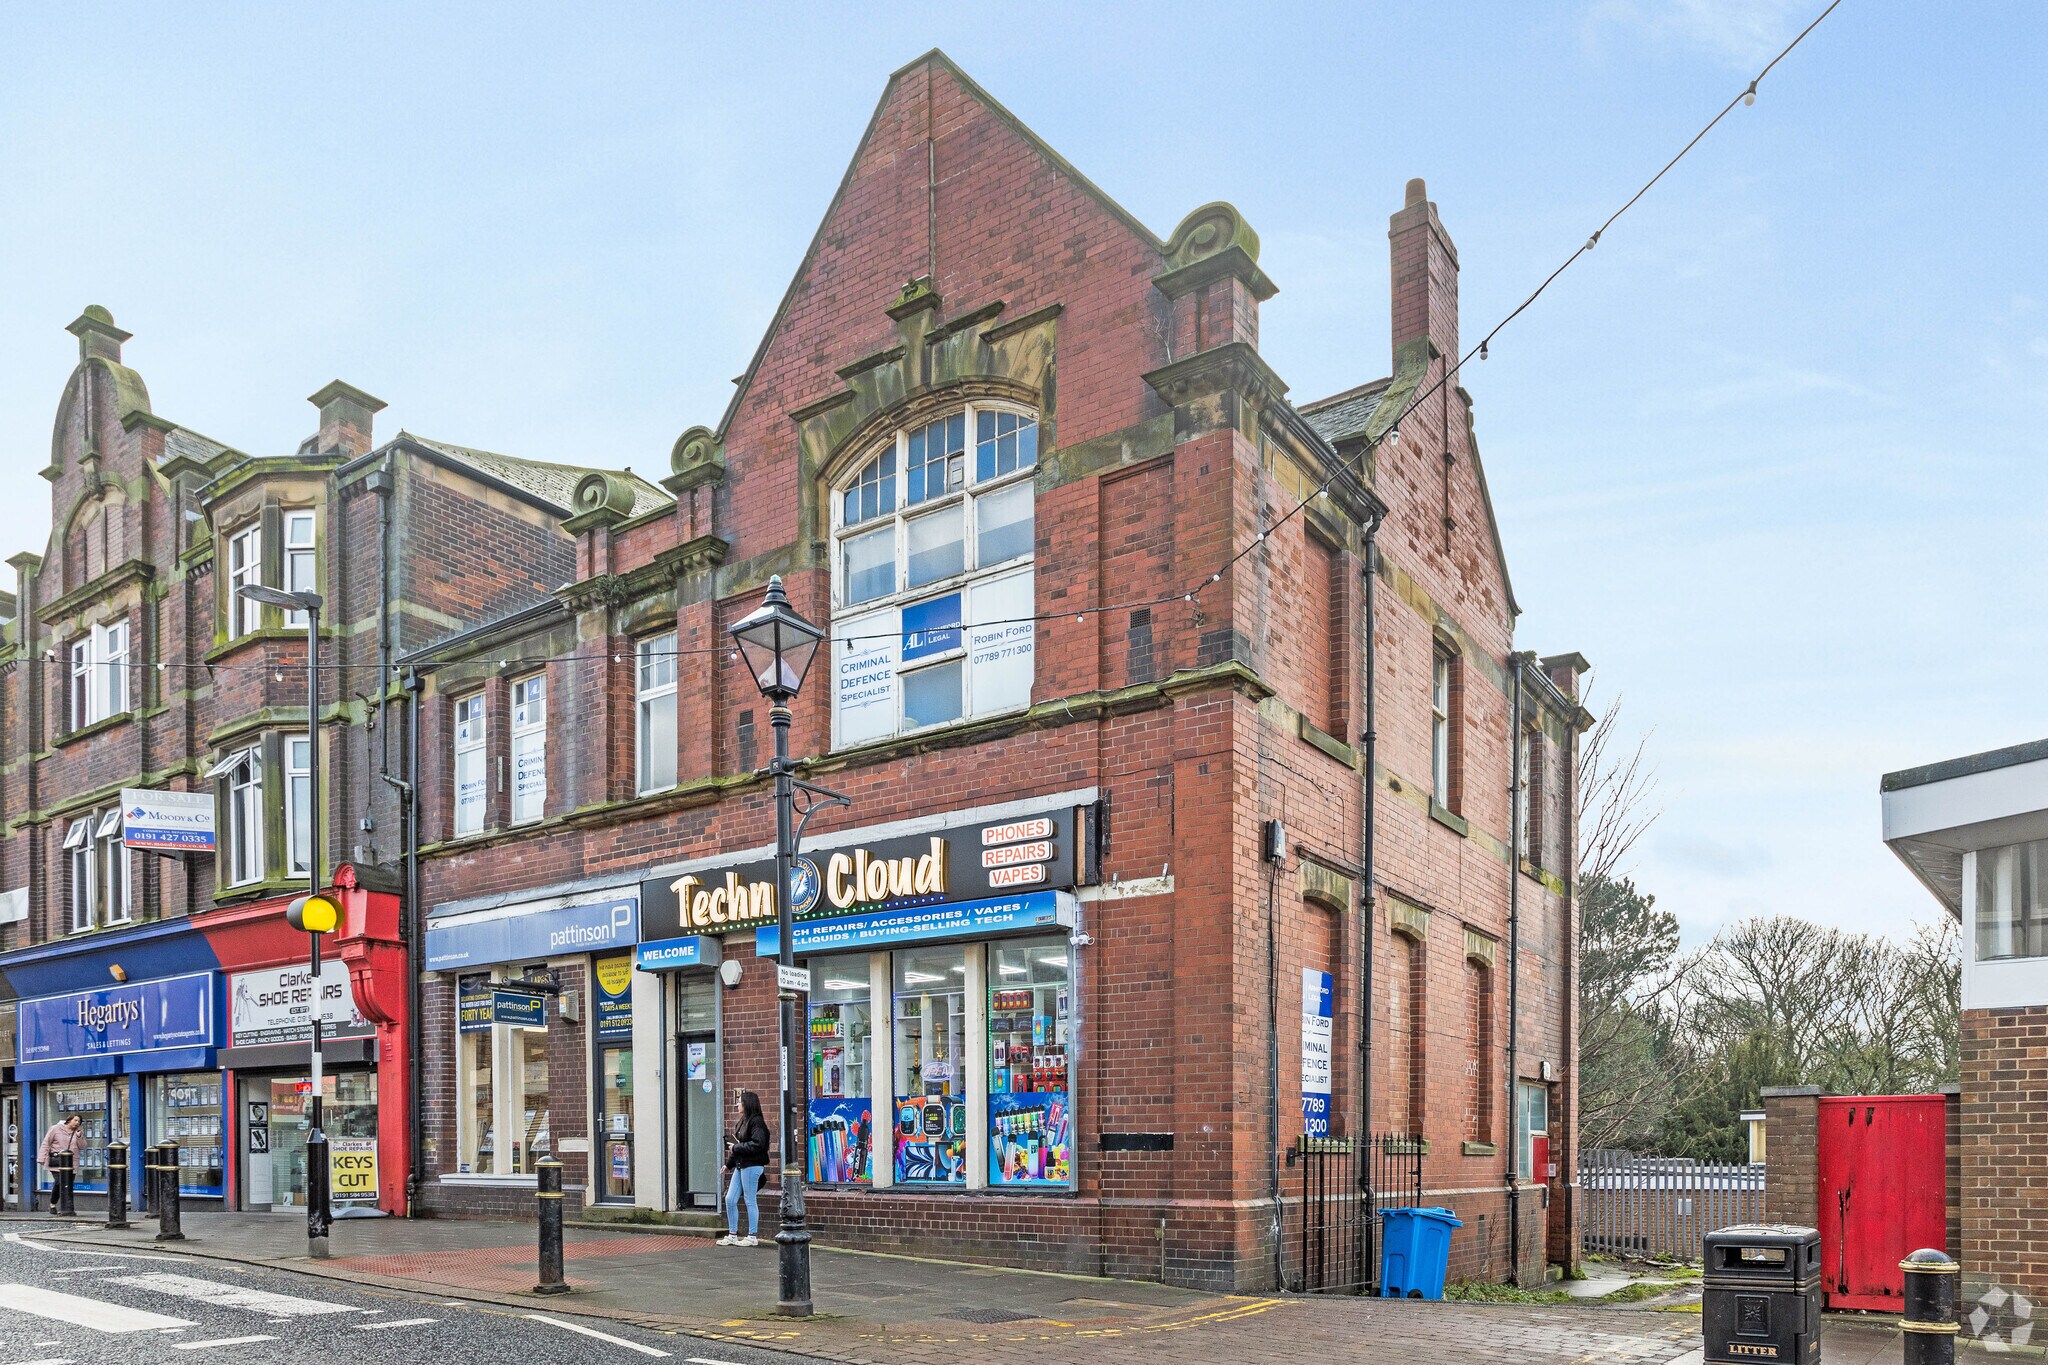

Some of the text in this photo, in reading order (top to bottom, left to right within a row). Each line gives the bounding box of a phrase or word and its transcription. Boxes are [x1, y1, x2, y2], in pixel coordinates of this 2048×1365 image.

[928, 633, 950, 644] LEGAL
[974, 625, 1032, 645] ROBIN FORD
[974, 644, 1032, 665] 07789 771300
[841, 654, 891, 674] CRIMINAL
[841, 670, 891, 689] DEFENCE
[841, 685, 891, 702] SPECIALIST
[518, 756, 545, 768] CRIMIN
[132, 791, 204, 804] FOR SALE
[148, 811, 186, 821] MOODY
[134, 832, 156, 840] 0191
[182, 835, 206, 843] 0335
[986, 821, 1044, 843] PHONES
[985, 844, 1046, 865] REPAIRS
[827, 836, 945, 909] Cloud
[992, 866, 1039, 884] VAPES
[870, 910, 963, 928] ACCESSORIES
[974, 903, 1021, 915] VAPES
[860, 920, 970, 938] BUYING-SELLING
[974, 914, 1014, 924] TECH
[550, 924, 610, 950] pattinson
[429, 951, 470, 962] www.pattinson.co.uk
[643, 946, 694, 960] WELCOME
[790, 970, 807, 980] loading
[258, 990, 289, 1007] SHOE
[497, 1001, 530, 1012] pattinson
[77, 997, 139, 1032] Hegartys
[461, 1008, 478, 1022] FORTY
[600, 1020, 611, 1028] 0191
[1312, 1016, 1330, 1028] FORD
[87, 1041, 102, 1050] SALES
[106, 1038, 131, 1048] LETTINGS
[333, 1156, 373, 1168] KEYS
[338, 1174, 369, 1186] CUT
[1729, 1344, 1777, 1356] LITTER
